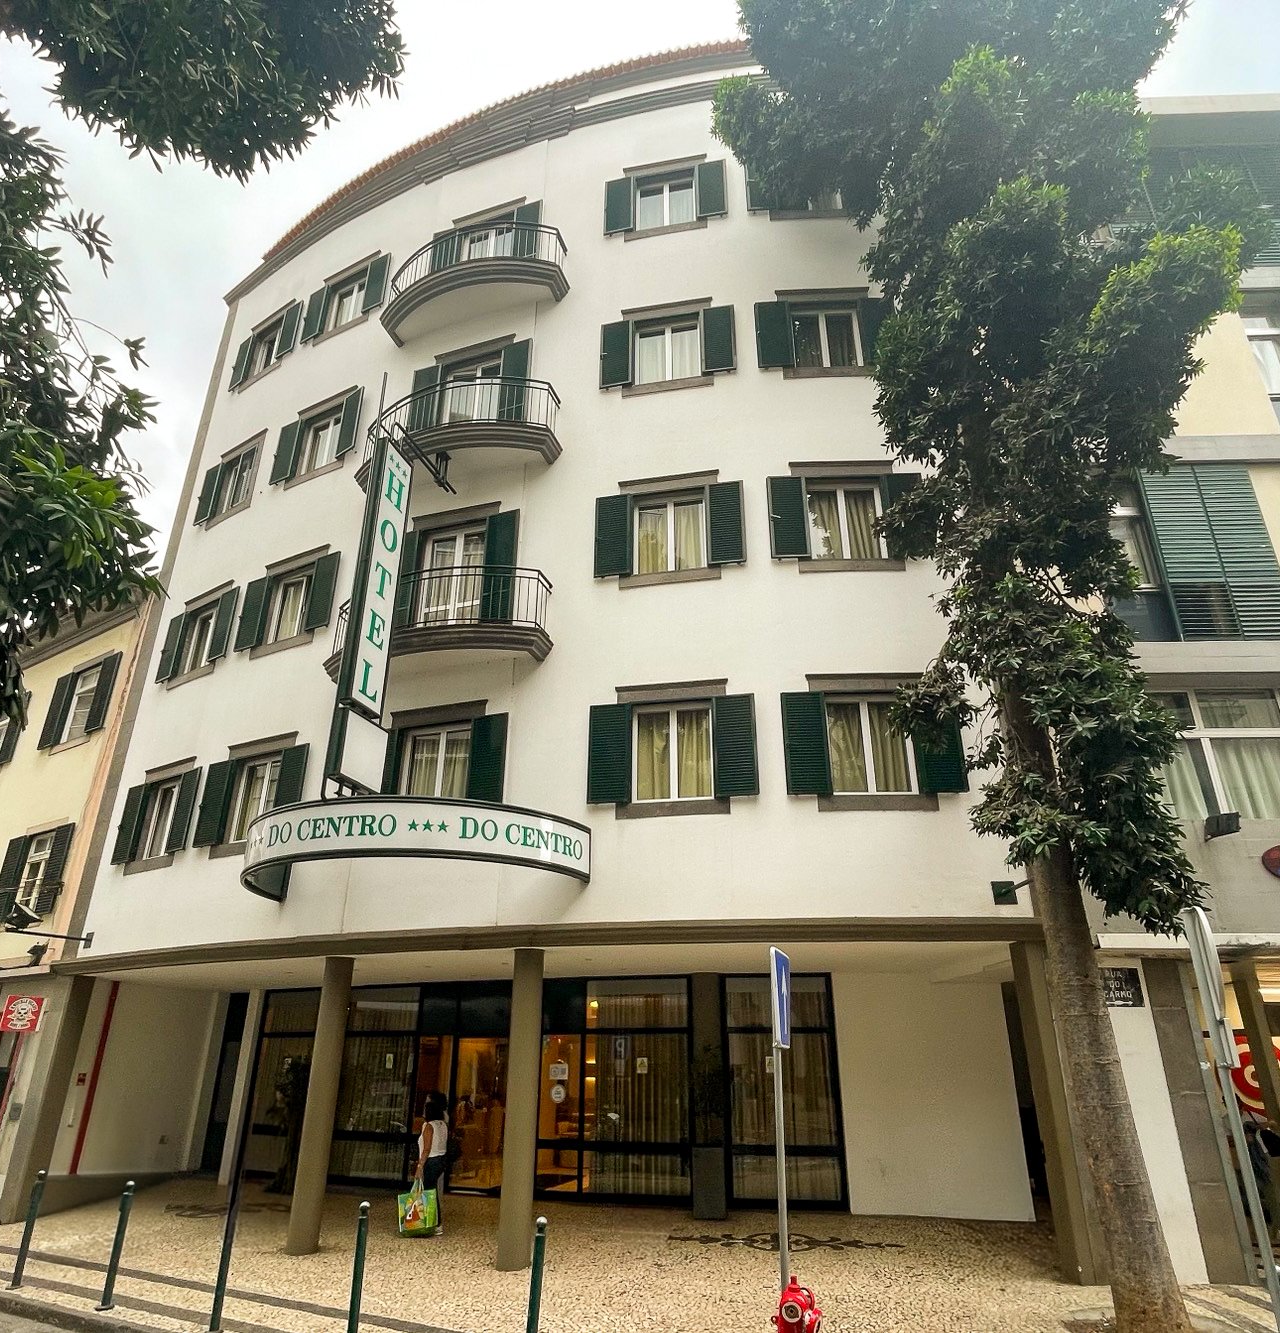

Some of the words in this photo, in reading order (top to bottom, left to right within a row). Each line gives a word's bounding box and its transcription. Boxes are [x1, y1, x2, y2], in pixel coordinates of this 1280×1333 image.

[358, 467, 406, 703] HOTEL
[267, 821, 293, 848] DO
[296, 813, 398, 842] CENTRO
[458, 816, 499, 842] DO
[504, 822, 584, 861] CENTRO
